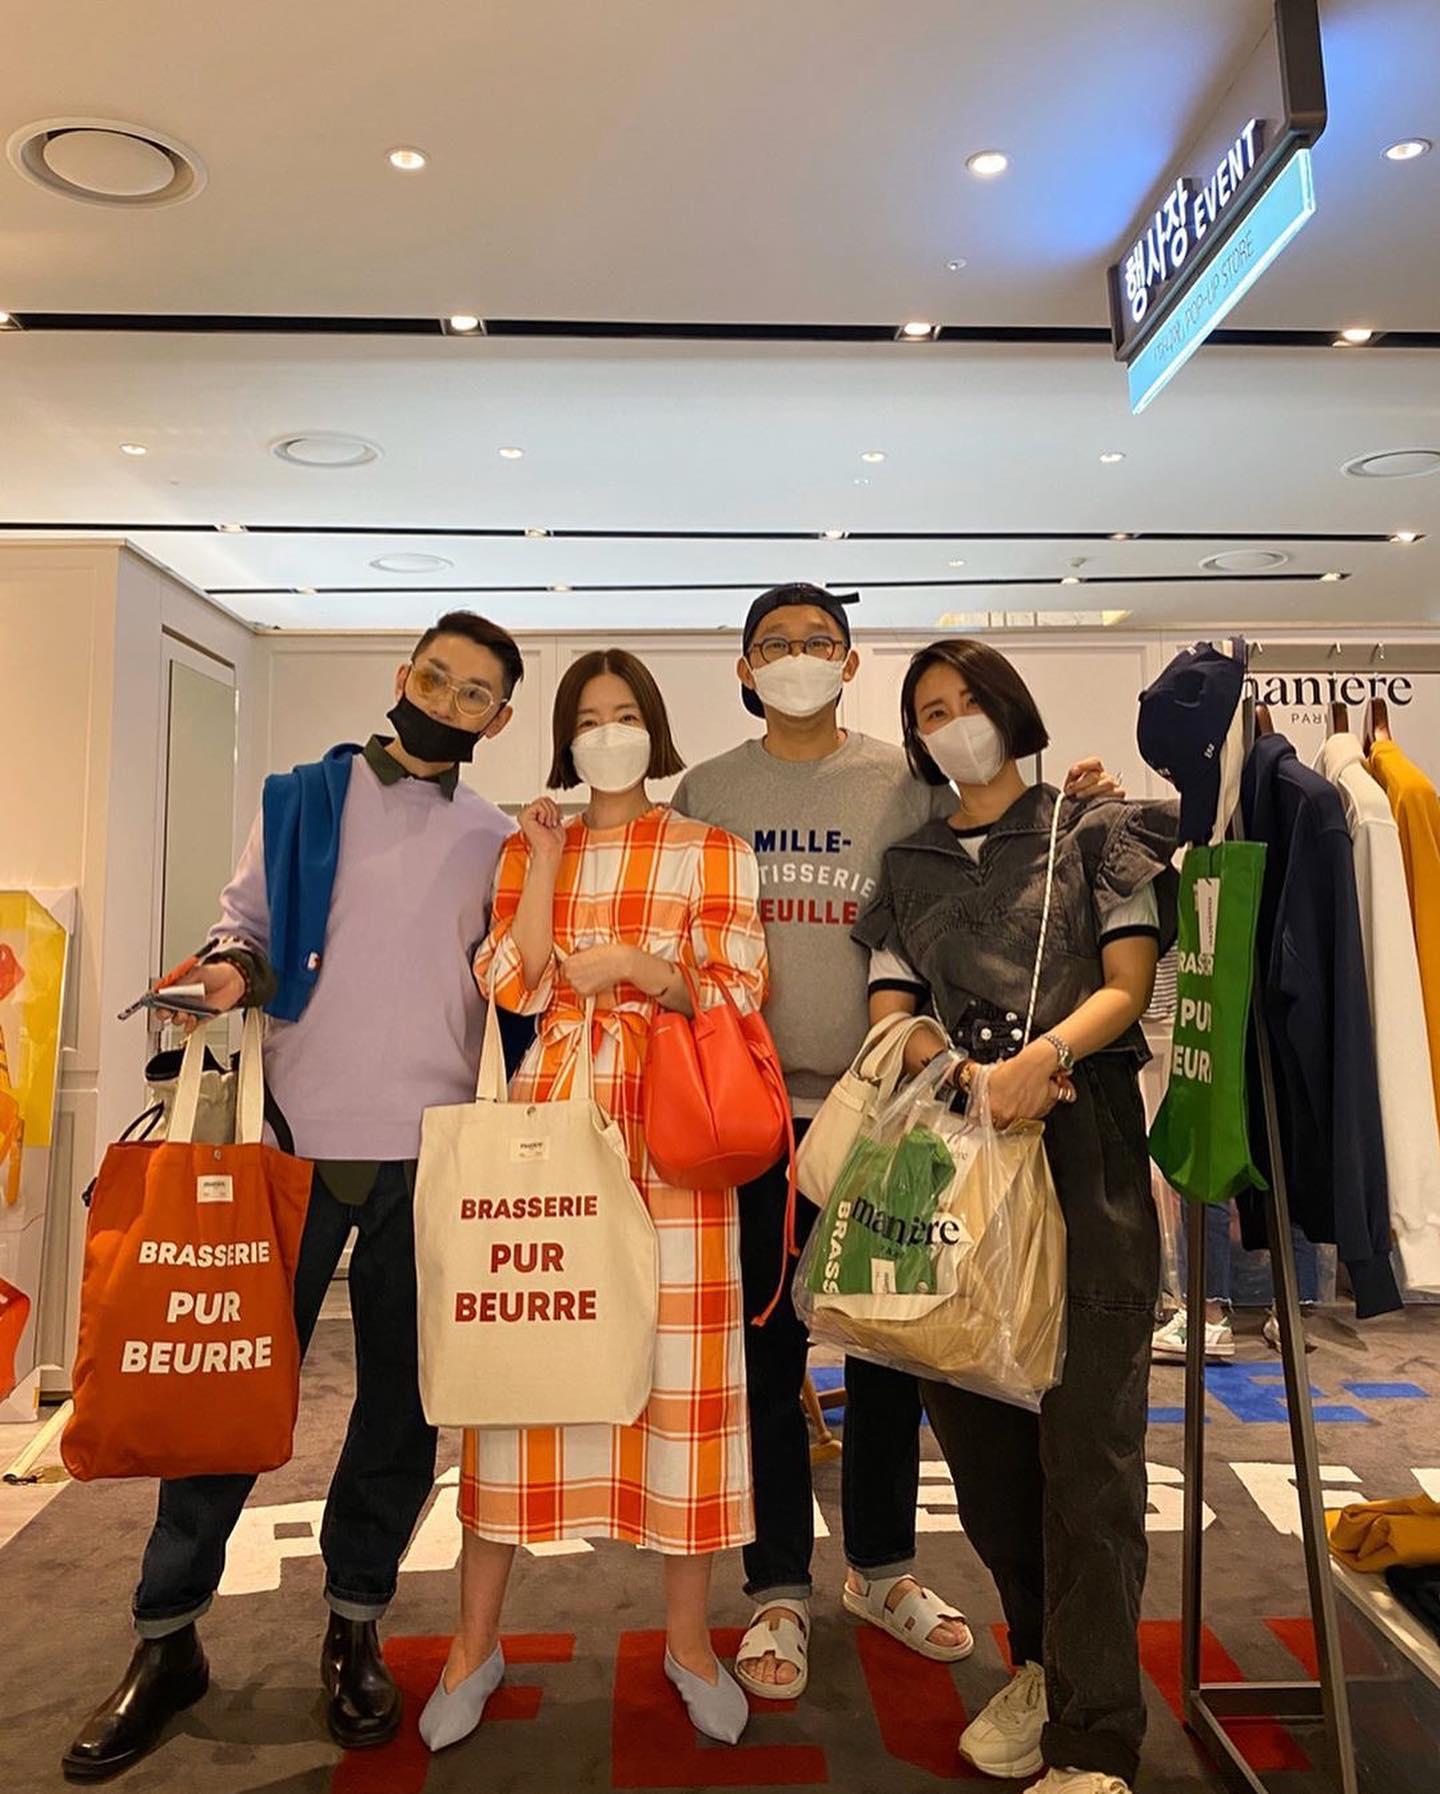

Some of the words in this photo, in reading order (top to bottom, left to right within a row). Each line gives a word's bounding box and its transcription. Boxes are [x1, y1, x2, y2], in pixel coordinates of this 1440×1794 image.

[1125, 177, 1189, 323] 행사장
[1194, 118, 1257, 239] EVENT
[1221, 230, 1255, 288] STORE
[754, 829, 852, 853] MILLE-
[460, 1195, 598, 1220] BRASSERIE
[138, 1241, 270, 1268] BRASSERIE
[490, 1243, 565, 1274] PUR
[166, 1291, 241, 1325] PUR
[454, 1290, 597, 1323] BEURRE
[120, 1336, 272, 1374] BEURRE
